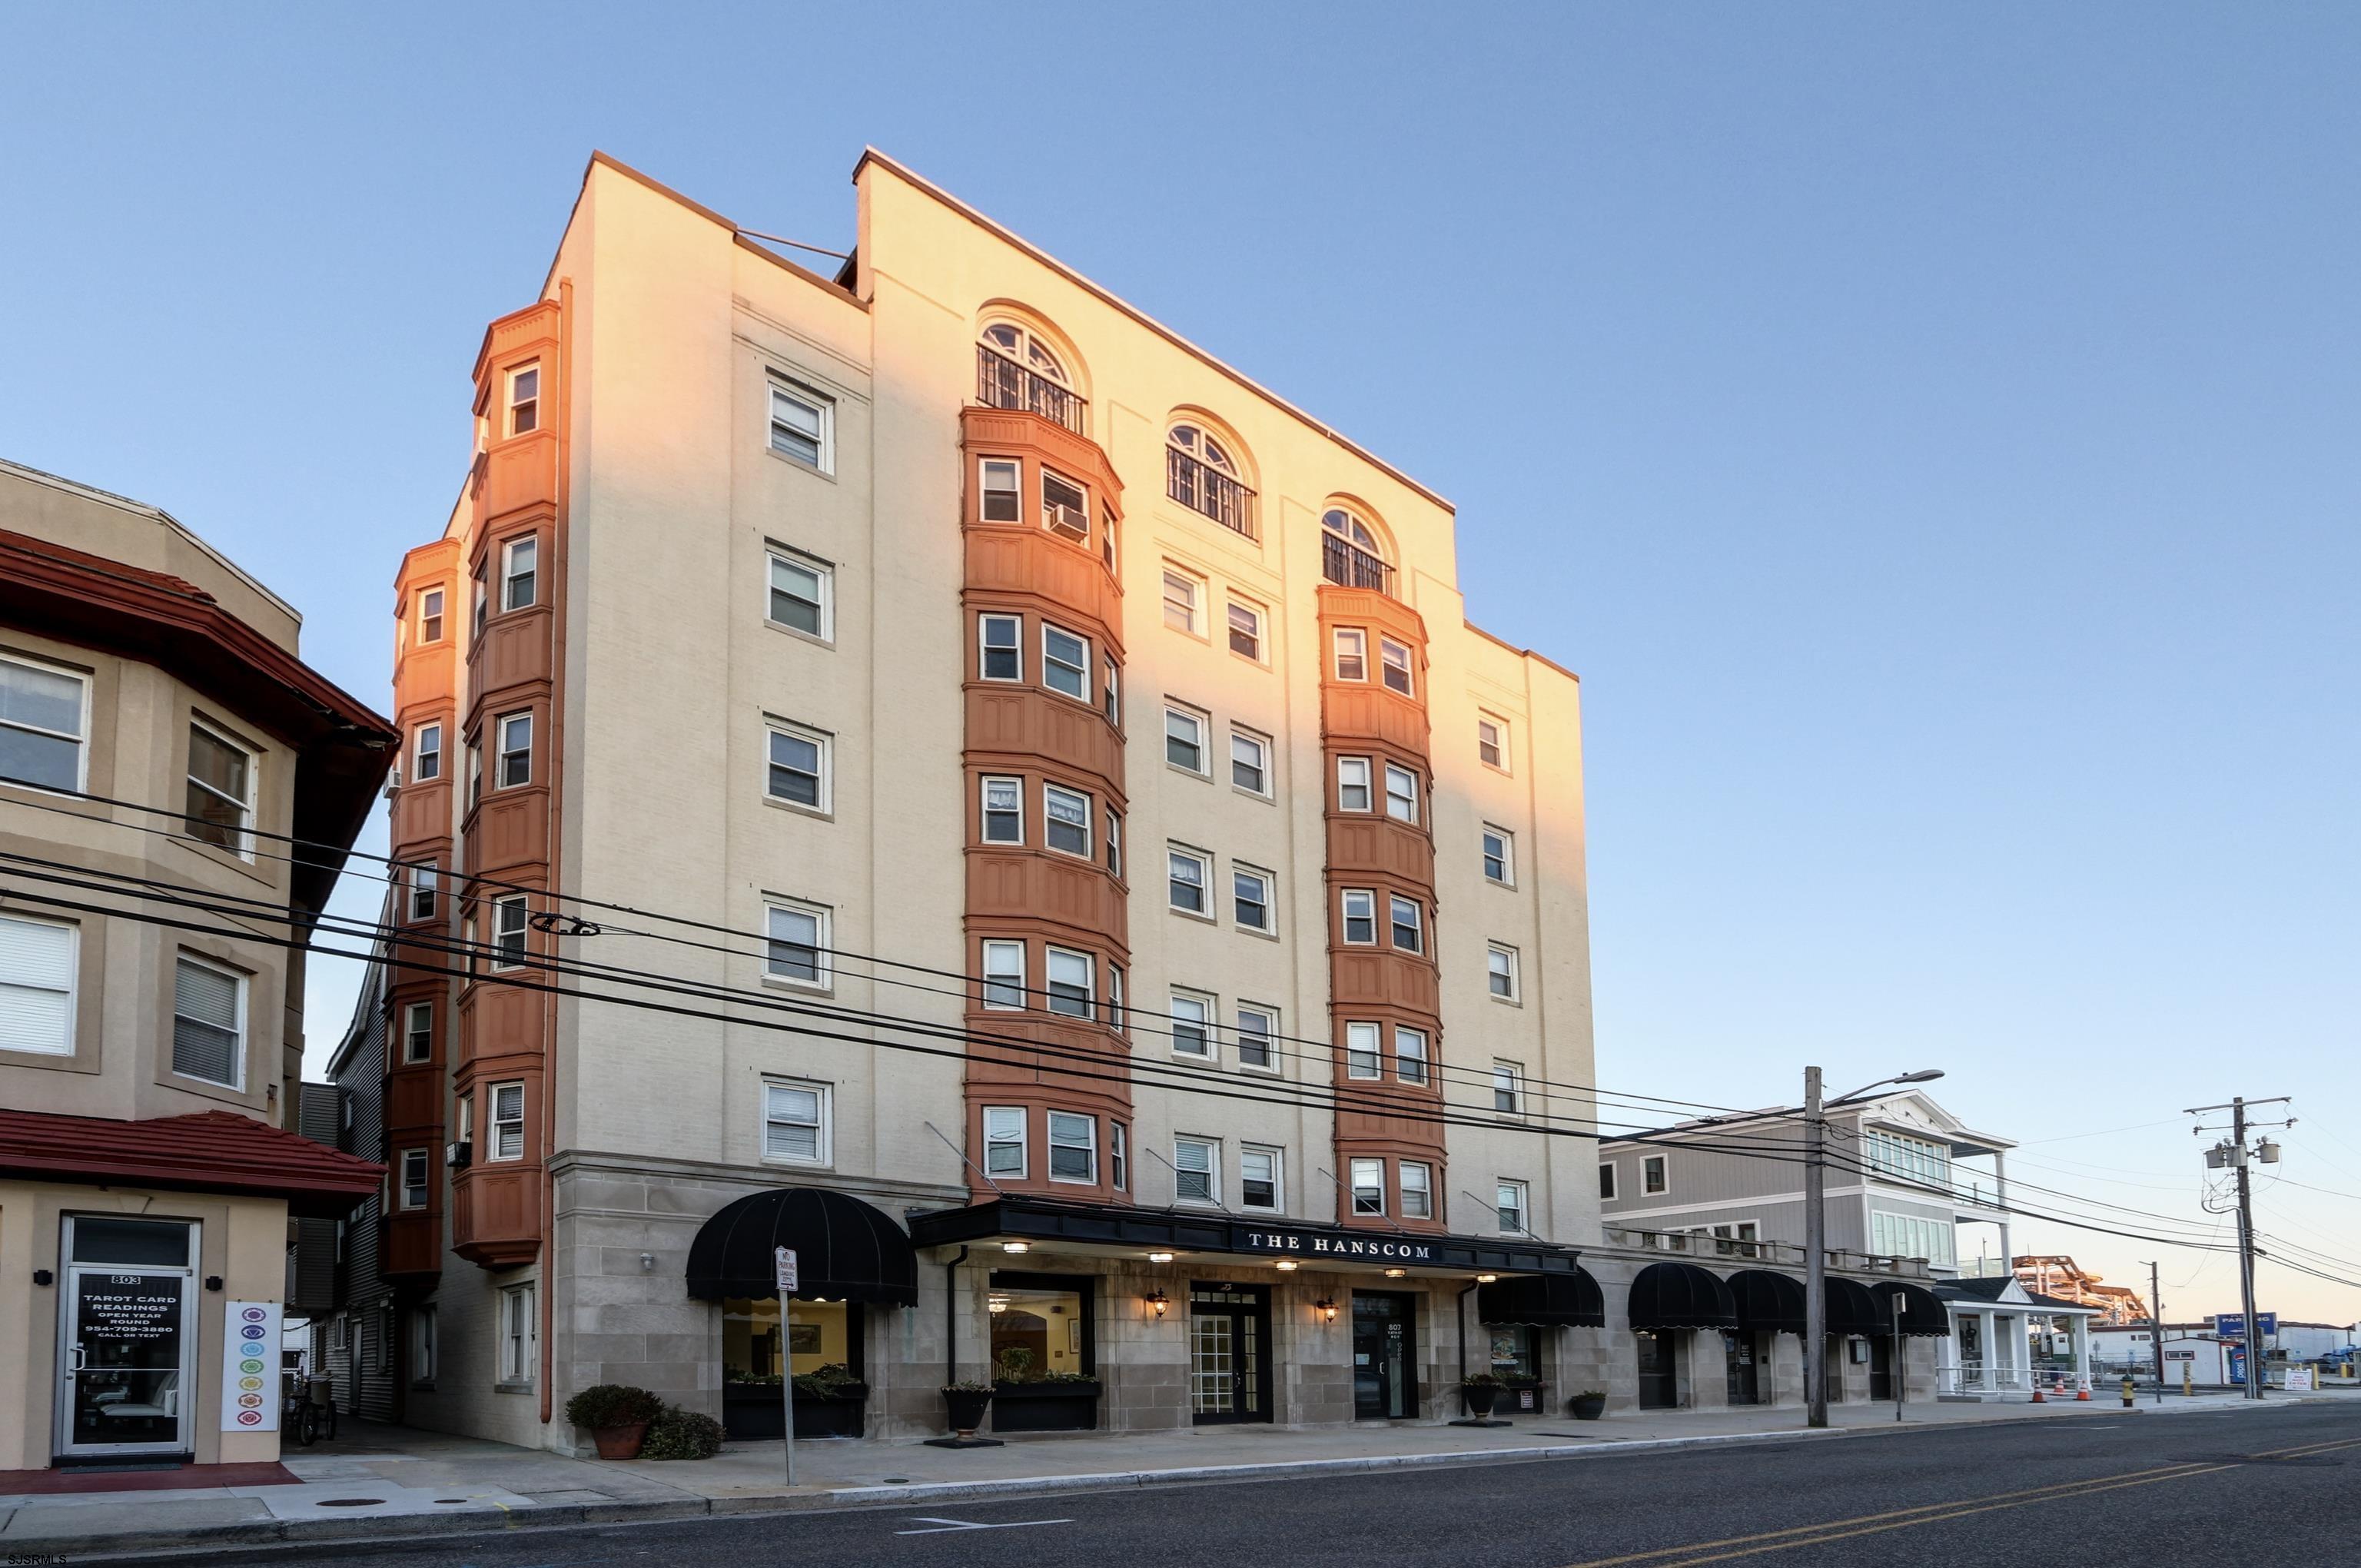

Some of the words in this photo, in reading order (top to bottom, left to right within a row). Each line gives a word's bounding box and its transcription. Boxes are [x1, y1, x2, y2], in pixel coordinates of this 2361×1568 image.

[1249, 1234, 1300, 1249] THE
[1314, 1238, 1430, 1258] HANSCOM
[2236, 1362, 2246, 1377] pepsi
